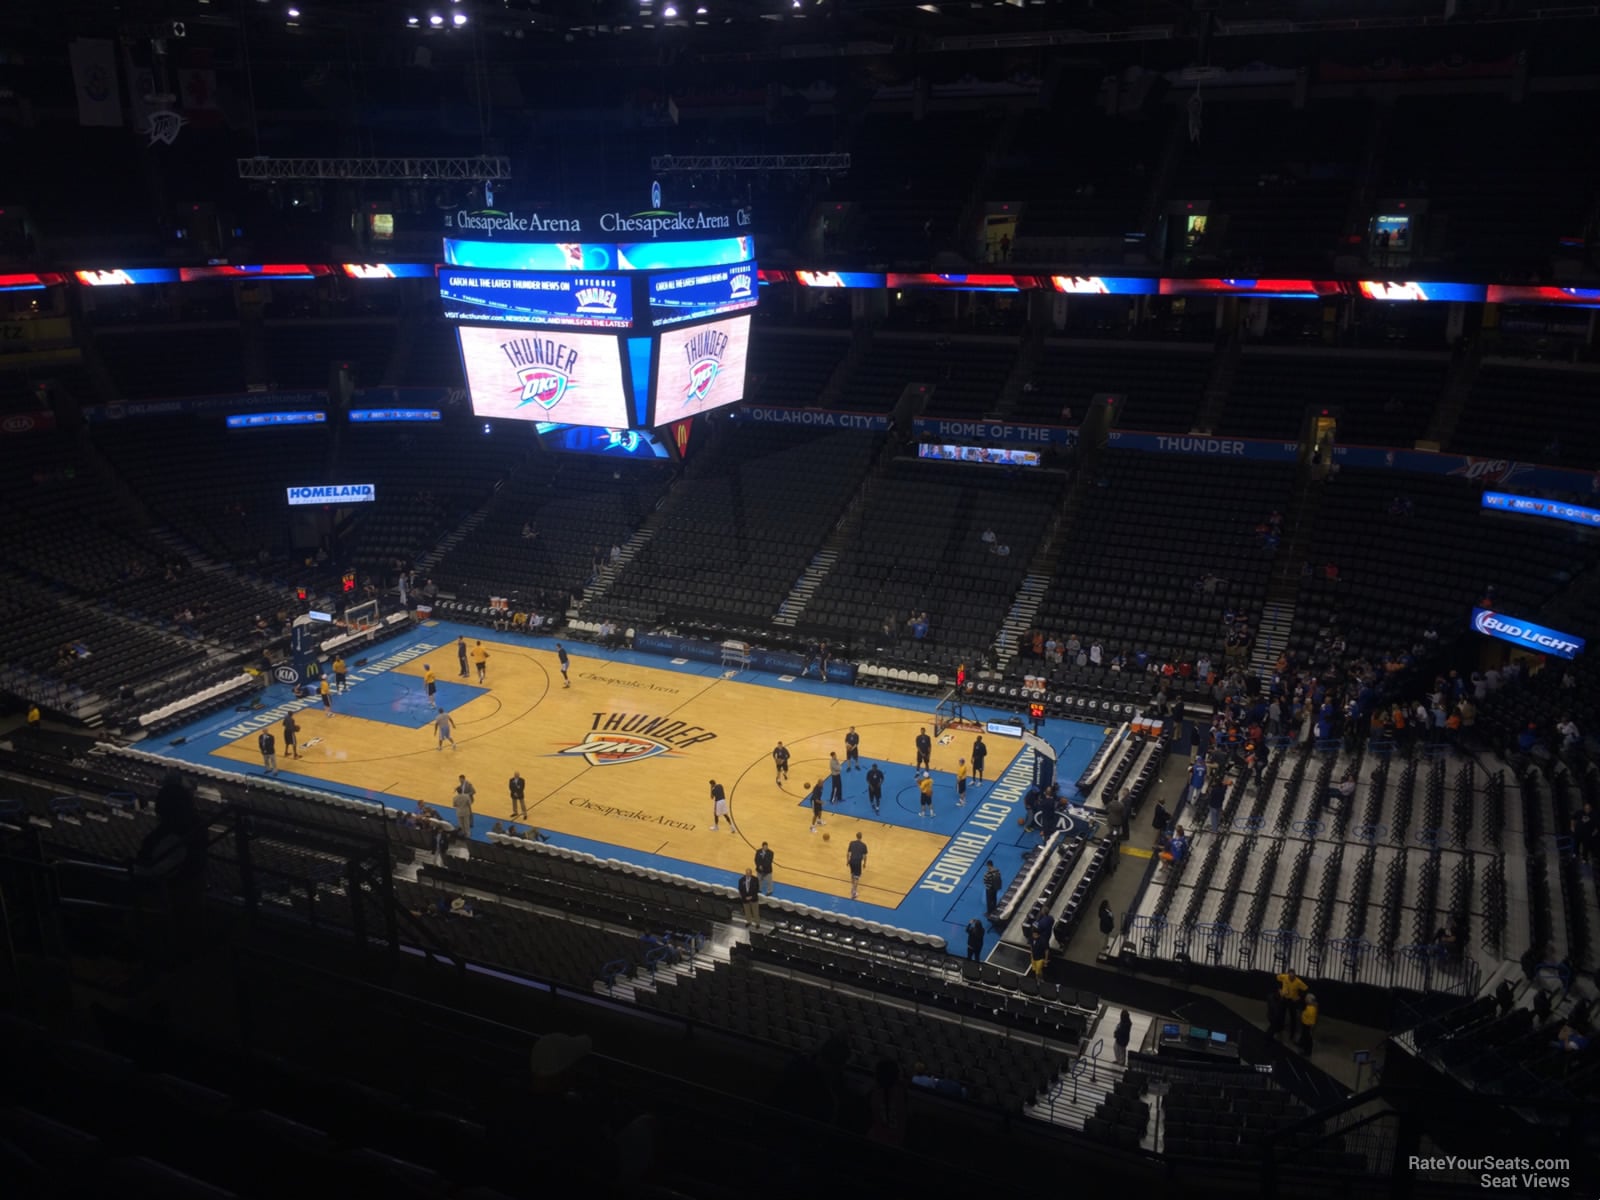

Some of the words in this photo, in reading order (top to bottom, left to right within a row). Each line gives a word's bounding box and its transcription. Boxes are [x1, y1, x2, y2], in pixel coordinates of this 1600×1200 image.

[457, 210, 528, 237] Chesapeake
[530, 213, 581, 231] Arena
[600, 211, 694, 238] Chesapeake
[695, 211, 729, 229] Arena
[449, 277, 467, 287] CATCH
[468, 278, 479, 287] ALL
[480, 278, 490, 288] THE
[491, 279, 511, 289] LATEST
[512, 280, 540, 290] THUNDER
[541, 281, 560, 291] NEWS
[560, 282, 570, 291] ON
[575, 278, 616, 288] INTEGRIS
[575, 287, 617, 308] THUNDER
[604, 320, 630, 328] LATEST
[500, 338, 579, 374] THUNDER
[684, 330, 729, 366] THUNDER
[520, 376, 558, 401] OKC
[753, 408, 835, 426] OKLAHOMA
[839, 414, 872, 428] CITY
[939, 421, 986, 437] HOME
[991, 425, 1013, 439] OF
[1016, 427, 1049, 441] THE
[1109, 432, 1120, 440] 117
[1156, 436, 1244, 455] THUNDER
[290, 485, 371, 498] HOMELAND
[1483, 617, 1522, 637] BUD
[1521, 629, 1579, 653] LIGHT
[357, 643, 439, 675] THUNDER
[278, 668, 295, 681] KIA
[591, 713, 717, 749] THUNDER
[569, 797, 652, 821] Chesapeake
[650, 815, 696, 831] Arena
[969, 802, 1012, 831] CITY
[920, 831, 993, 894] THUNDER
